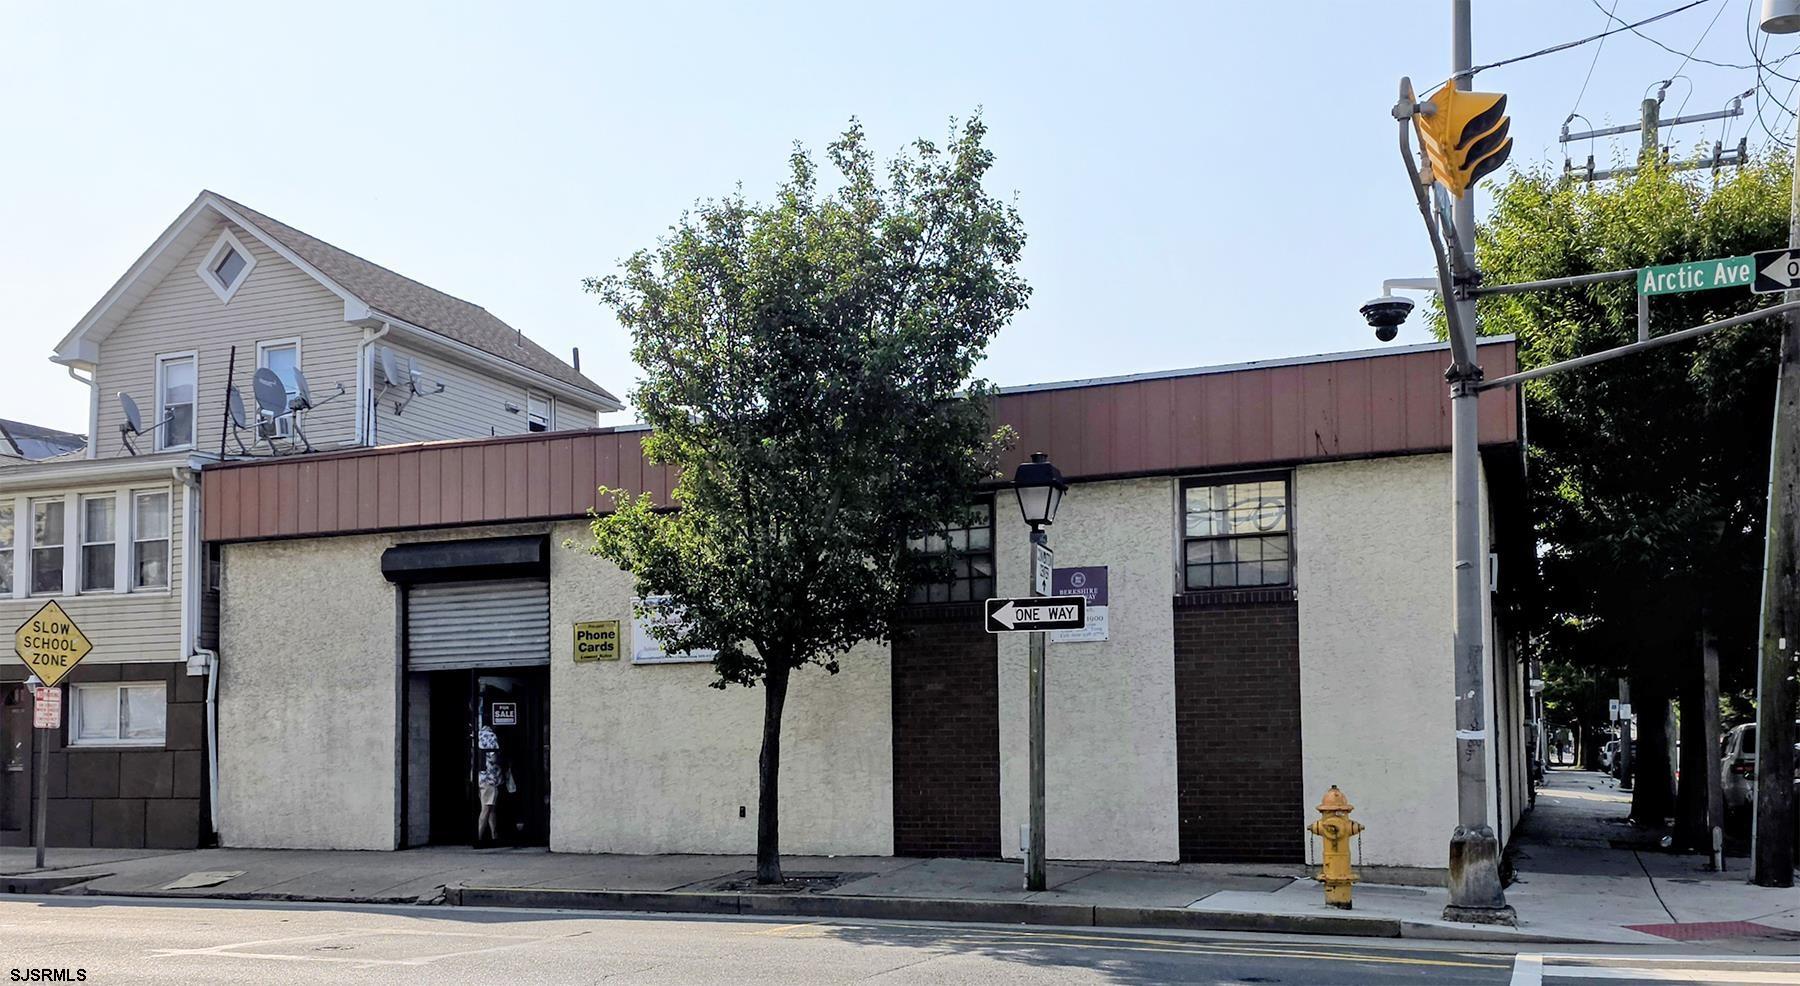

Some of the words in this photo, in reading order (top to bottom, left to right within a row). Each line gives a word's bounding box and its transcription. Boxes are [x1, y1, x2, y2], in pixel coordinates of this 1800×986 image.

[1643, 265, 1704, 292] Arctic
[1713, 262, 1750, 285] Ave
[1015, 608, 1040, 621] ONE
[1048, 607, 1074, 620] WAY
[33, 621, 70, 635] SLOW
[577, 630, 616, 641] Phone
[24, 636, 77, 652] SCHOOL
[578, 641, 614, 653] Cards
[32, 653, 68, 667] ZONE
[494, 710, 514, 718] SALE
